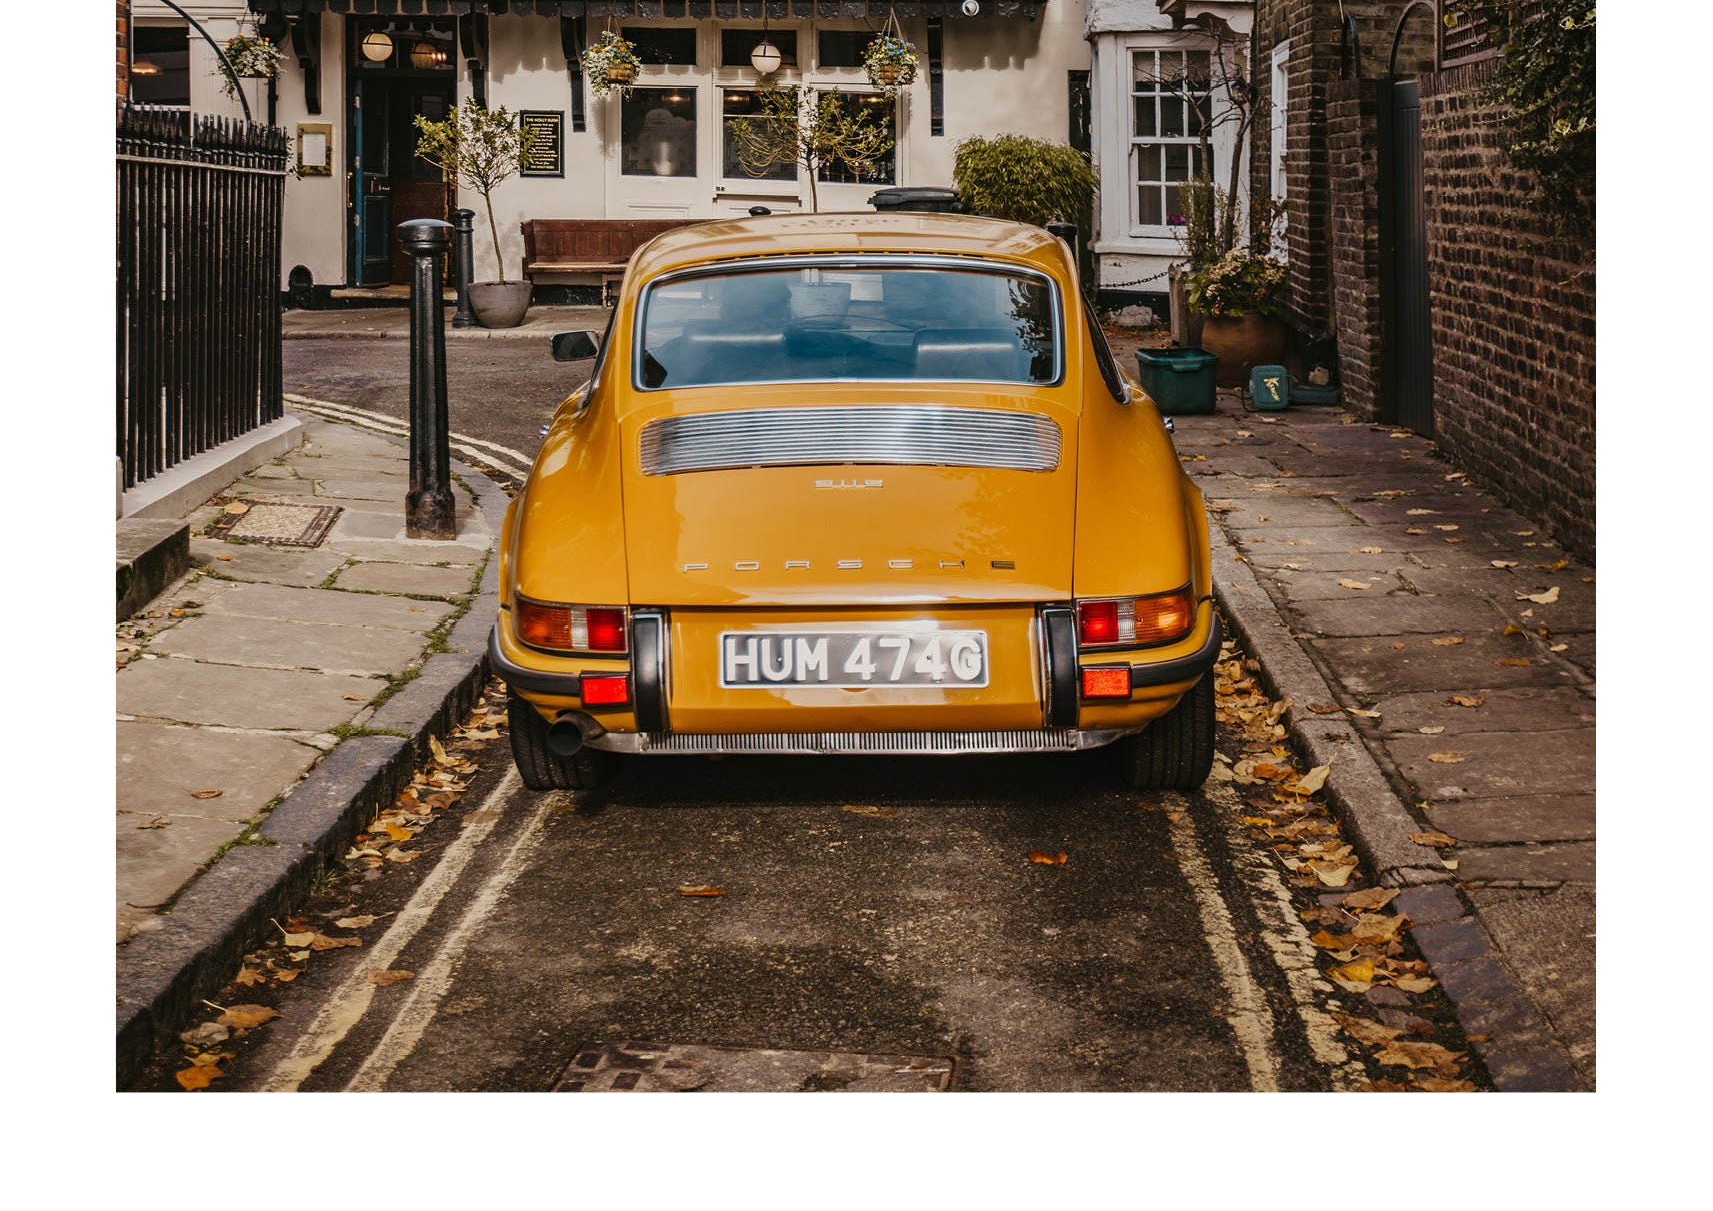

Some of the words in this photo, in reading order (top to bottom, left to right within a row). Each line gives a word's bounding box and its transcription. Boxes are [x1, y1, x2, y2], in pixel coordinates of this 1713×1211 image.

[683, 559, 1016, 573] PORSCHE
[726, 637, 829, 682] HUM
[843, 637, 982, 682] 474G
